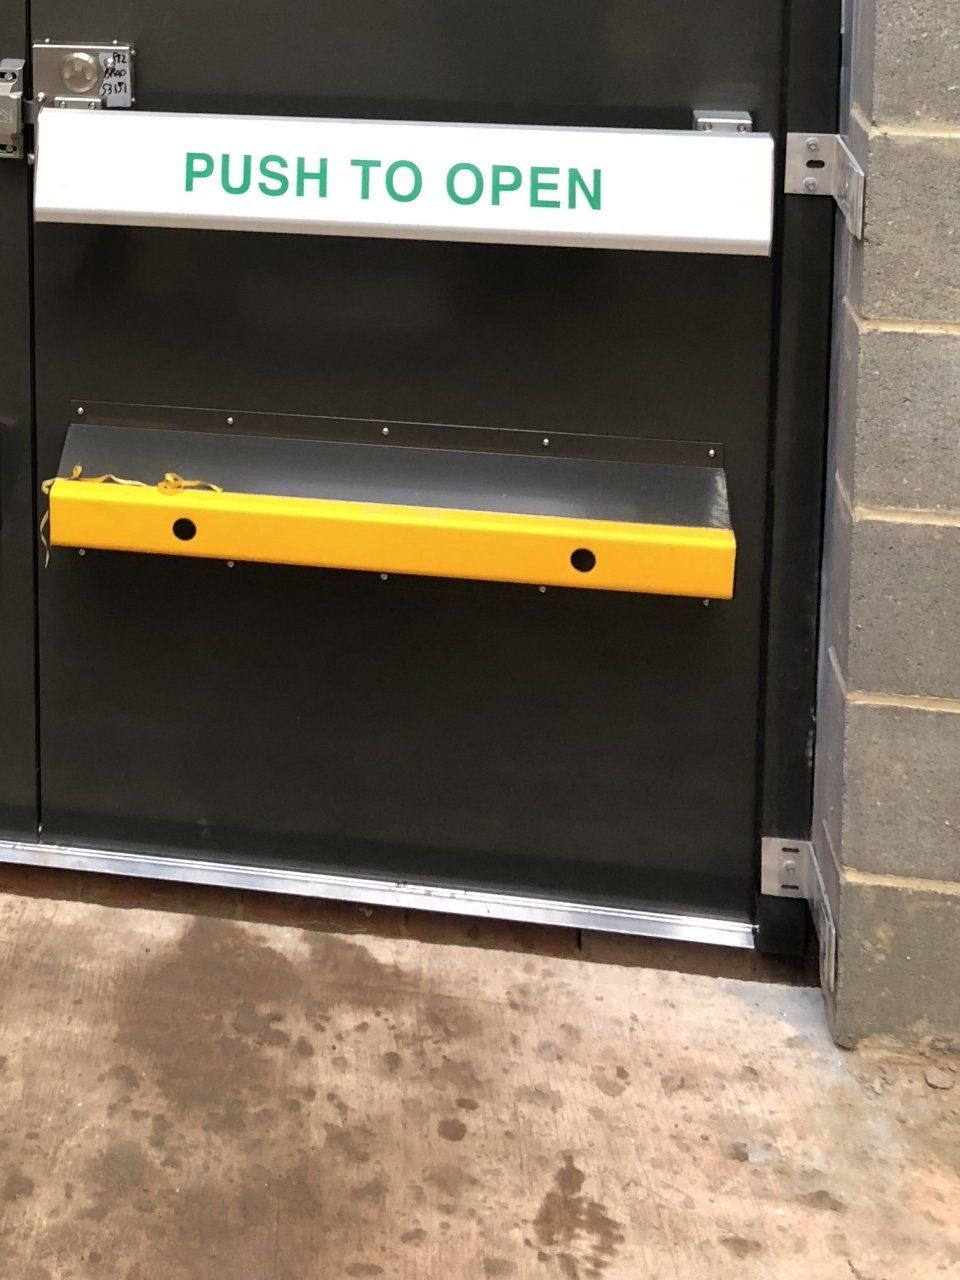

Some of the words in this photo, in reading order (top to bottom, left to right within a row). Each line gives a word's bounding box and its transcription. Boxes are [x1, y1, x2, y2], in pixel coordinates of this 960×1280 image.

[184, 151, 328, 199] PUSH
[351, 159, 423, 203] TO
[445, 162, 603, 211] OPEN
